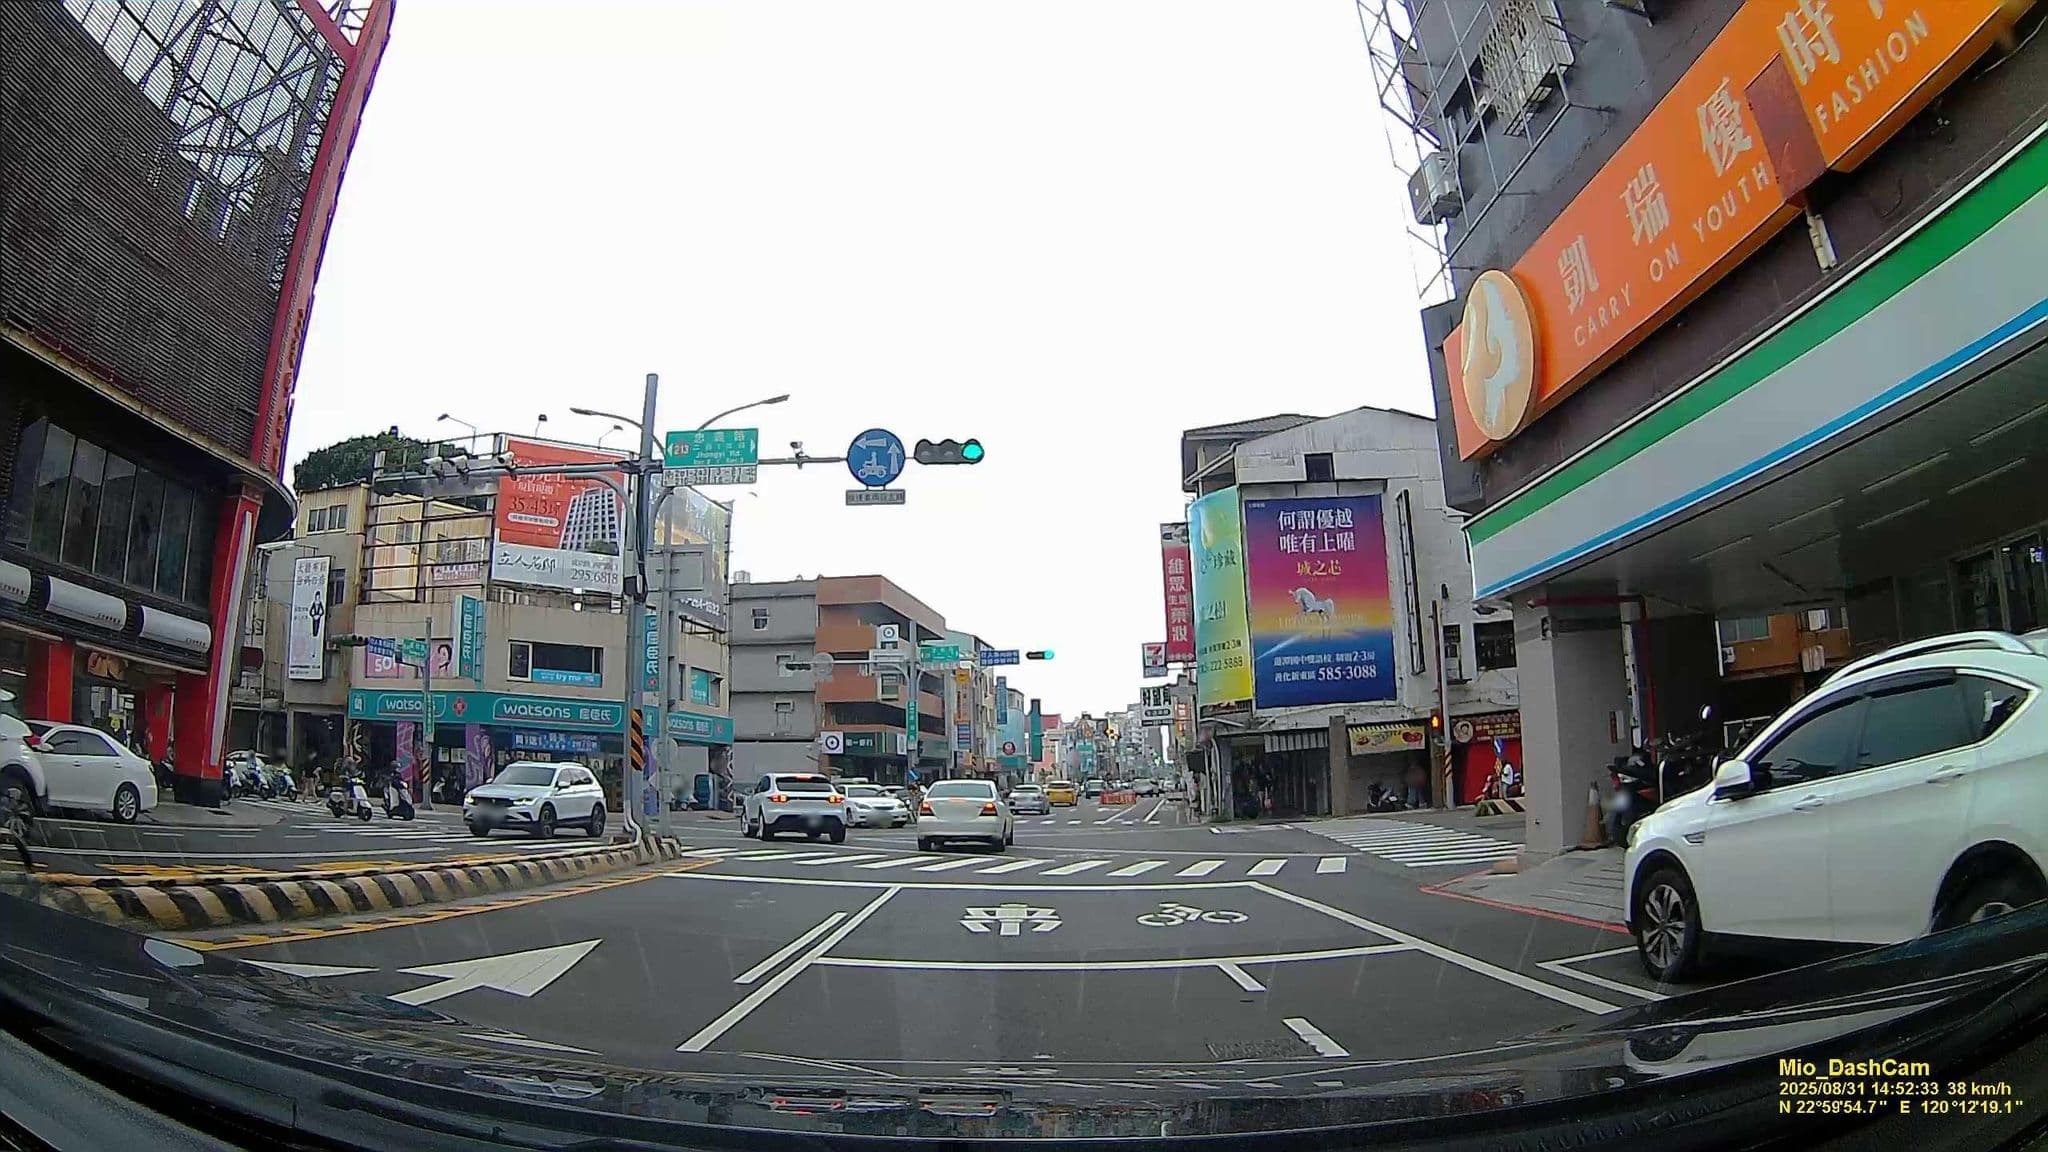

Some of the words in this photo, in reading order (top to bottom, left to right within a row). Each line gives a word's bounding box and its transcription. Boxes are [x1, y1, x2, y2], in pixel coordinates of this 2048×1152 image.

[1557, 0, 1884, 314] 凱瑞優時
[1574, 282, 1632, 346] CARRY
[1648, 247, 1682, 284] ON
[1692, 161, 1771, 242] YOUTH
[1814, 10, 1930, 134] FASHION
[1278, 508, 1353, 530] 何謂優越
[1279, 531, 1355, 553] 唯有上曜
[1297, 560, 1341, 576] 城之芯
[386, 699, 436, 713] watsos
[503, 704, 571, 718] watsons
